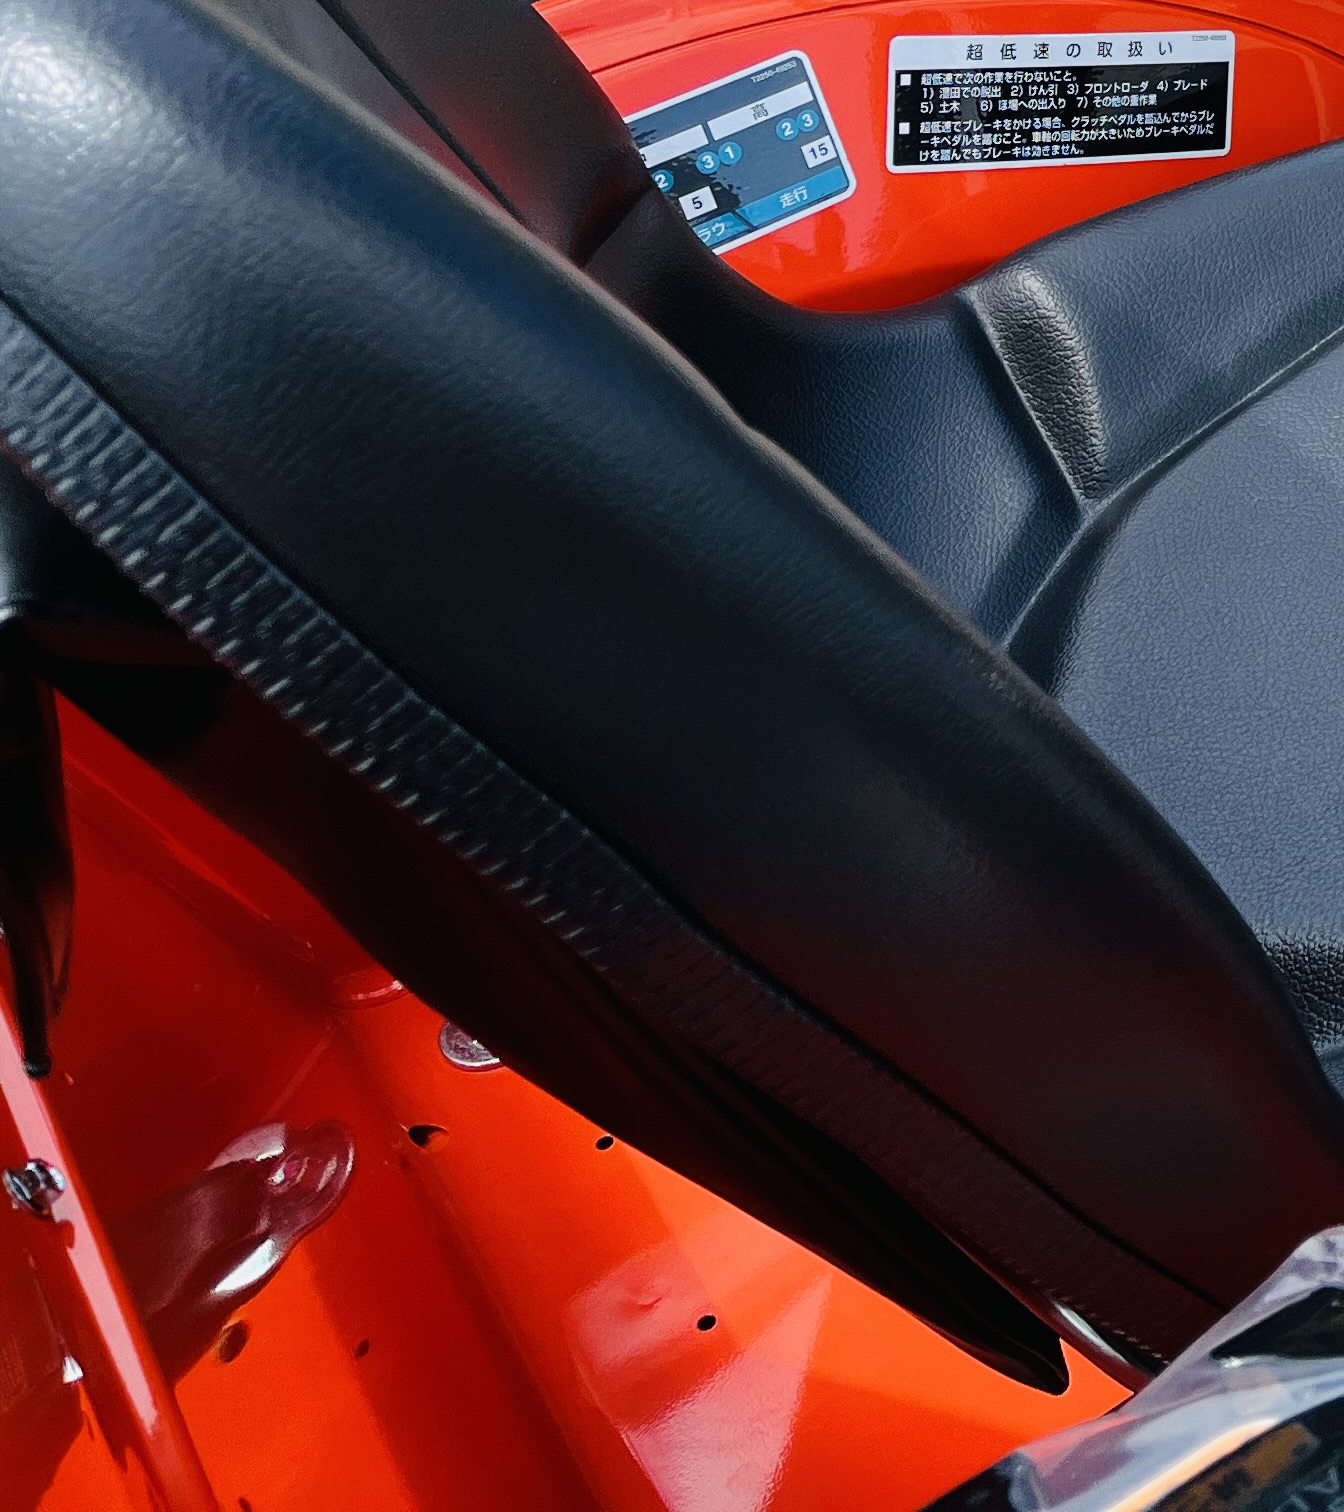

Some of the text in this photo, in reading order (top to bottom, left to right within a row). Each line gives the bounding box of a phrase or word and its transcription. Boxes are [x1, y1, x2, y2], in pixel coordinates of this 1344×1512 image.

[966, 40, 1173, 61] 超低速の取扱い
[1084, 81, 1149, 95] フロントローダ
[750, 102, 769, 120] 高
[939, 101, 961, 114] 土木
[808, 143, 828, 160] 15
[691, 196, 703, 211] 5
[780, 186, 809, 209] 走行
